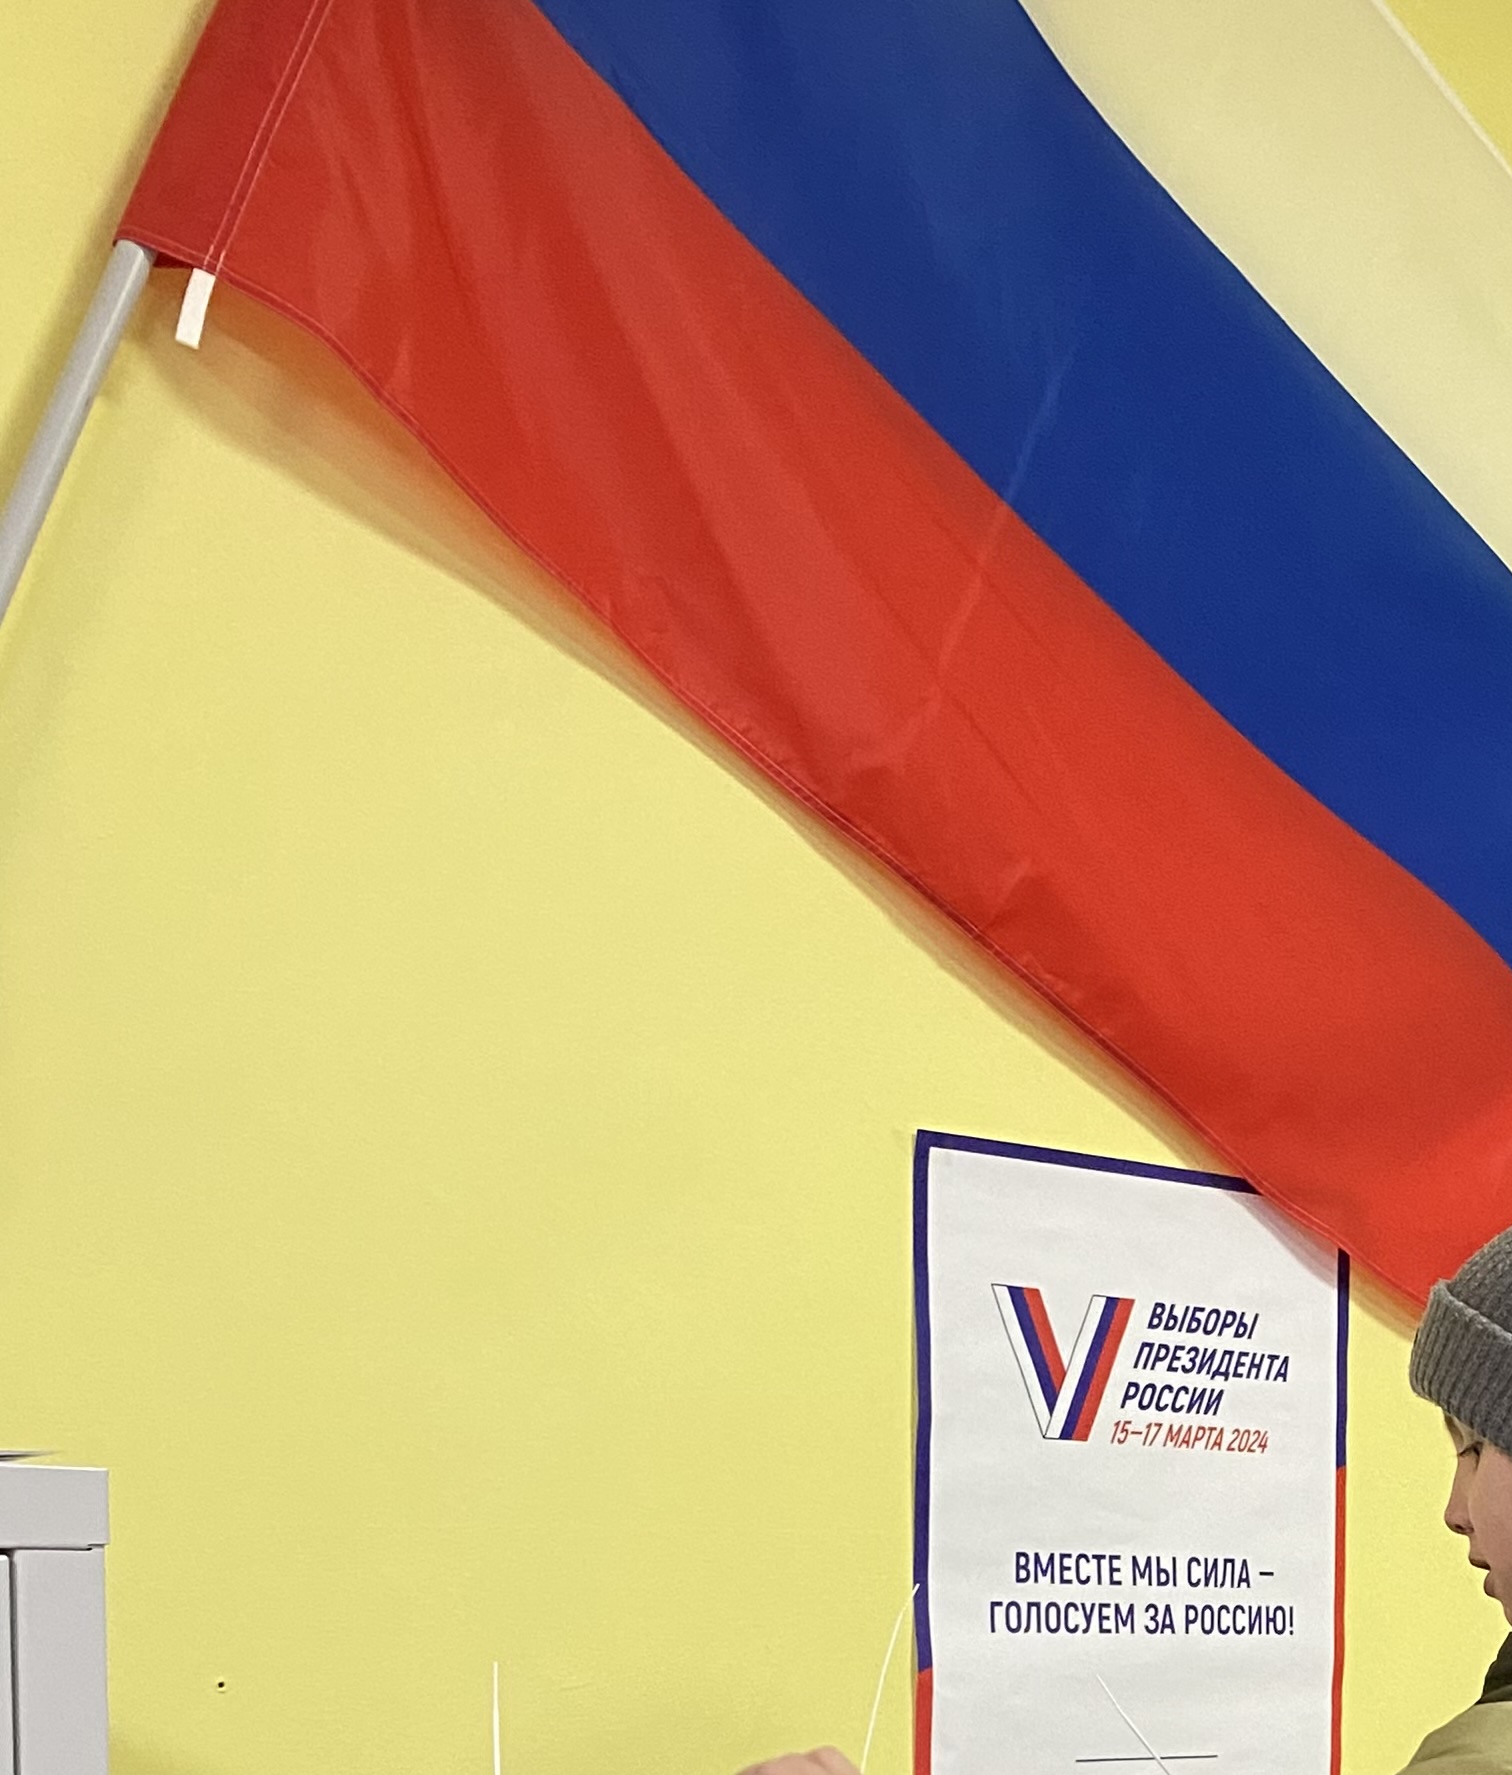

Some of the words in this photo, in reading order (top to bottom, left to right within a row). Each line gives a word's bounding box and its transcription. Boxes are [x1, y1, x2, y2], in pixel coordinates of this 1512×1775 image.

[1147, 1302, 1259, 1340] ВЫБОРЫ
[1133, 1341, 1290, 1383] ПРЕЗИДЕНТА
[1120, 1382, 1225, 1416] РОССИИ
[1162, 1424, 1225, 1451] МАРТА
[1226, 1428, 1270, 1454] 2024
[1014, 1551, 1122, 1586] ВМЕСТЕ
[1131, 1555, 1178, 1588] МЫ
[1187, 1556, 1252, 1589] СИЛА
[989, 1600, 1136, 1635] ГОЛОСУЕМ
[1144, 1603, 1176, 1635] ЗА
[1184, 1603, 1295, 1636] РОССИЮ!
